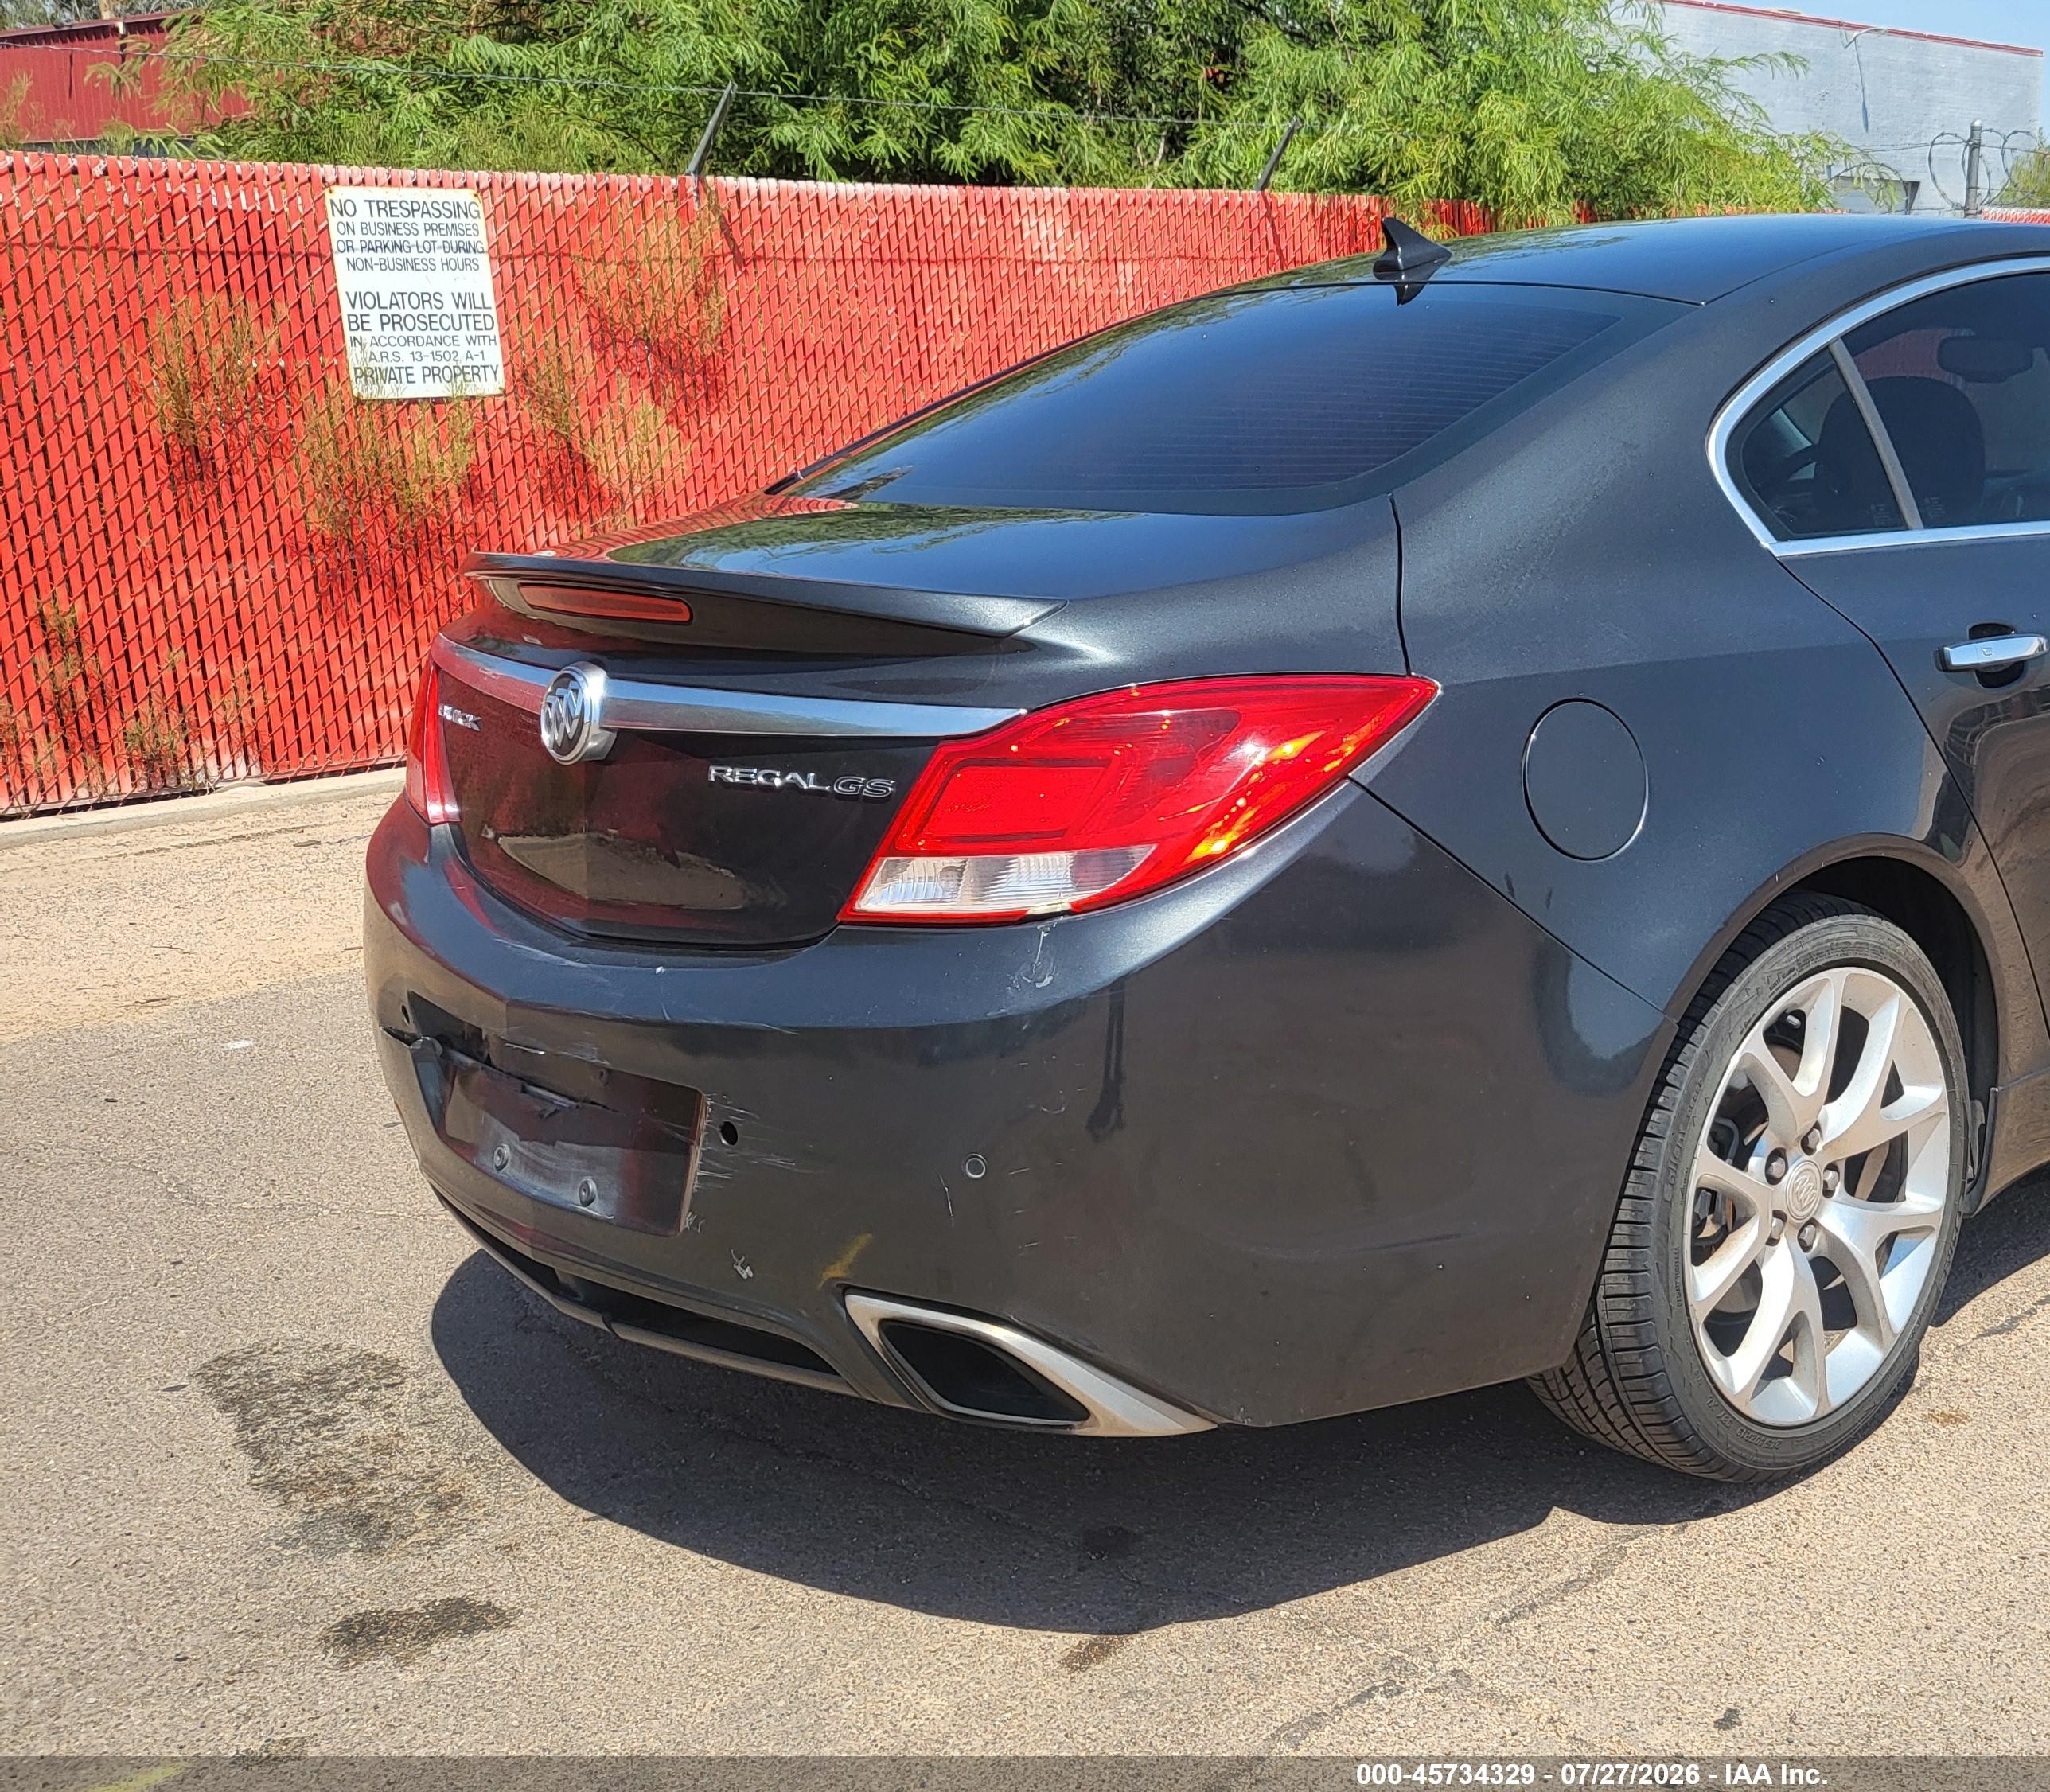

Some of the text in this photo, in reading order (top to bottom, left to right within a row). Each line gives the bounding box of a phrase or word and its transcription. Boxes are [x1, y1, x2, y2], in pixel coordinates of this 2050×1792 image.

[329, 199, 481, 220] NO TRESPASSING
[337, 222, 480, 236] ON BUSINESS PREMISES
[337, 240, 485, 254] OR PARKING LOT DURING
[346, 258, 480, 271] NON-BUSINESS HOURS
[345, 291, 492, 310] VIOLATORS WILL
[347, 314, 495, 332] BE PROSECUTED
[349, 335, 497, 347] IN ACCORDANCE WITH
[368, 350, 485, 363] A.R.S. 13-1502 A-1
[353, 364, 499, 384] PRIVATE PROPERTY
[707, 765, 896, 798] REGAL GS
